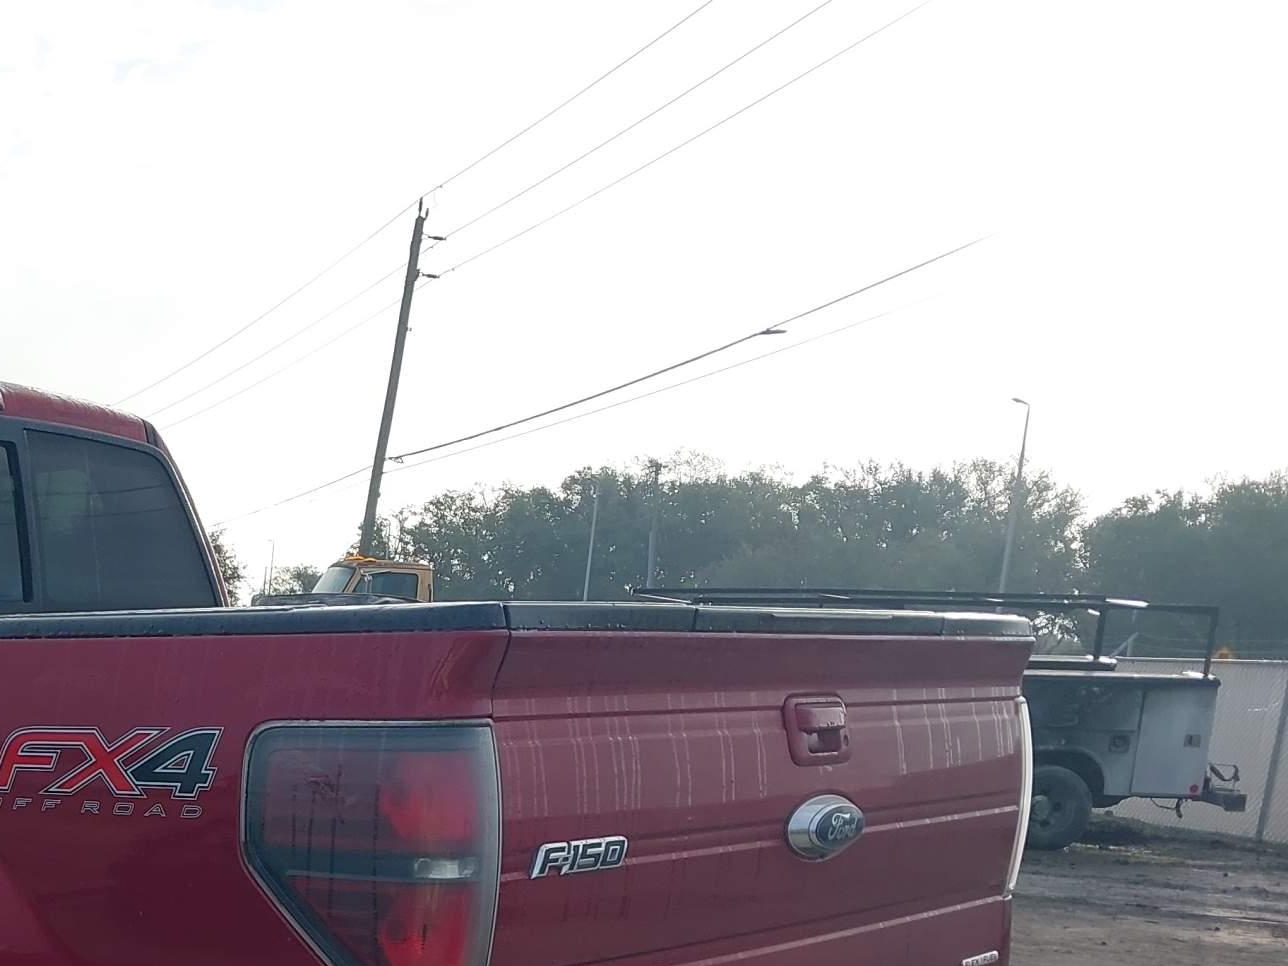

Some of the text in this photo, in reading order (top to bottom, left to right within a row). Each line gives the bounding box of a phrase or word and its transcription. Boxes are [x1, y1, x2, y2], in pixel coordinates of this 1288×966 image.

[81, 800, 203, 818] ROAD
[827, 812, 858, 840] Ford
[530, 836, 628, 879] F-150
